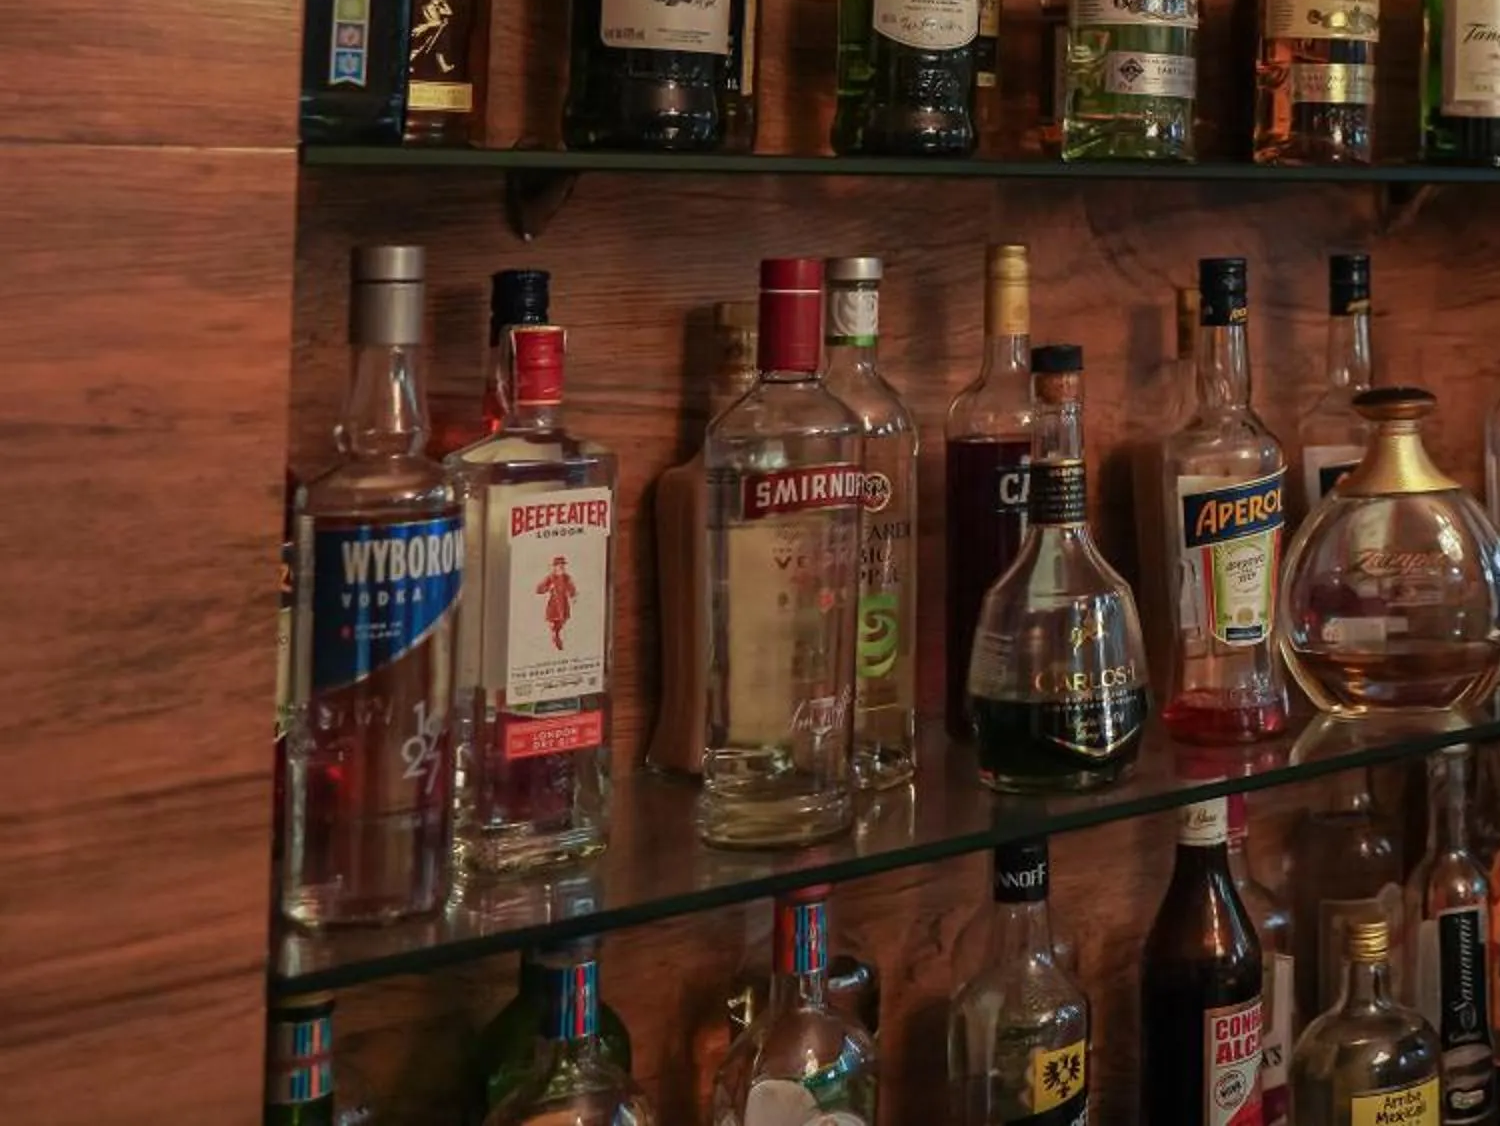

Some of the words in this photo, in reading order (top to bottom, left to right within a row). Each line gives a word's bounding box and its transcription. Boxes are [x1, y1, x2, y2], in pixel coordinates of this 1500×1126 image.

[510, 499, 609, 539] BEEFEATER
[536, 526, 584, 540] LONDON
[341, 587, 423, 609] VODKA
